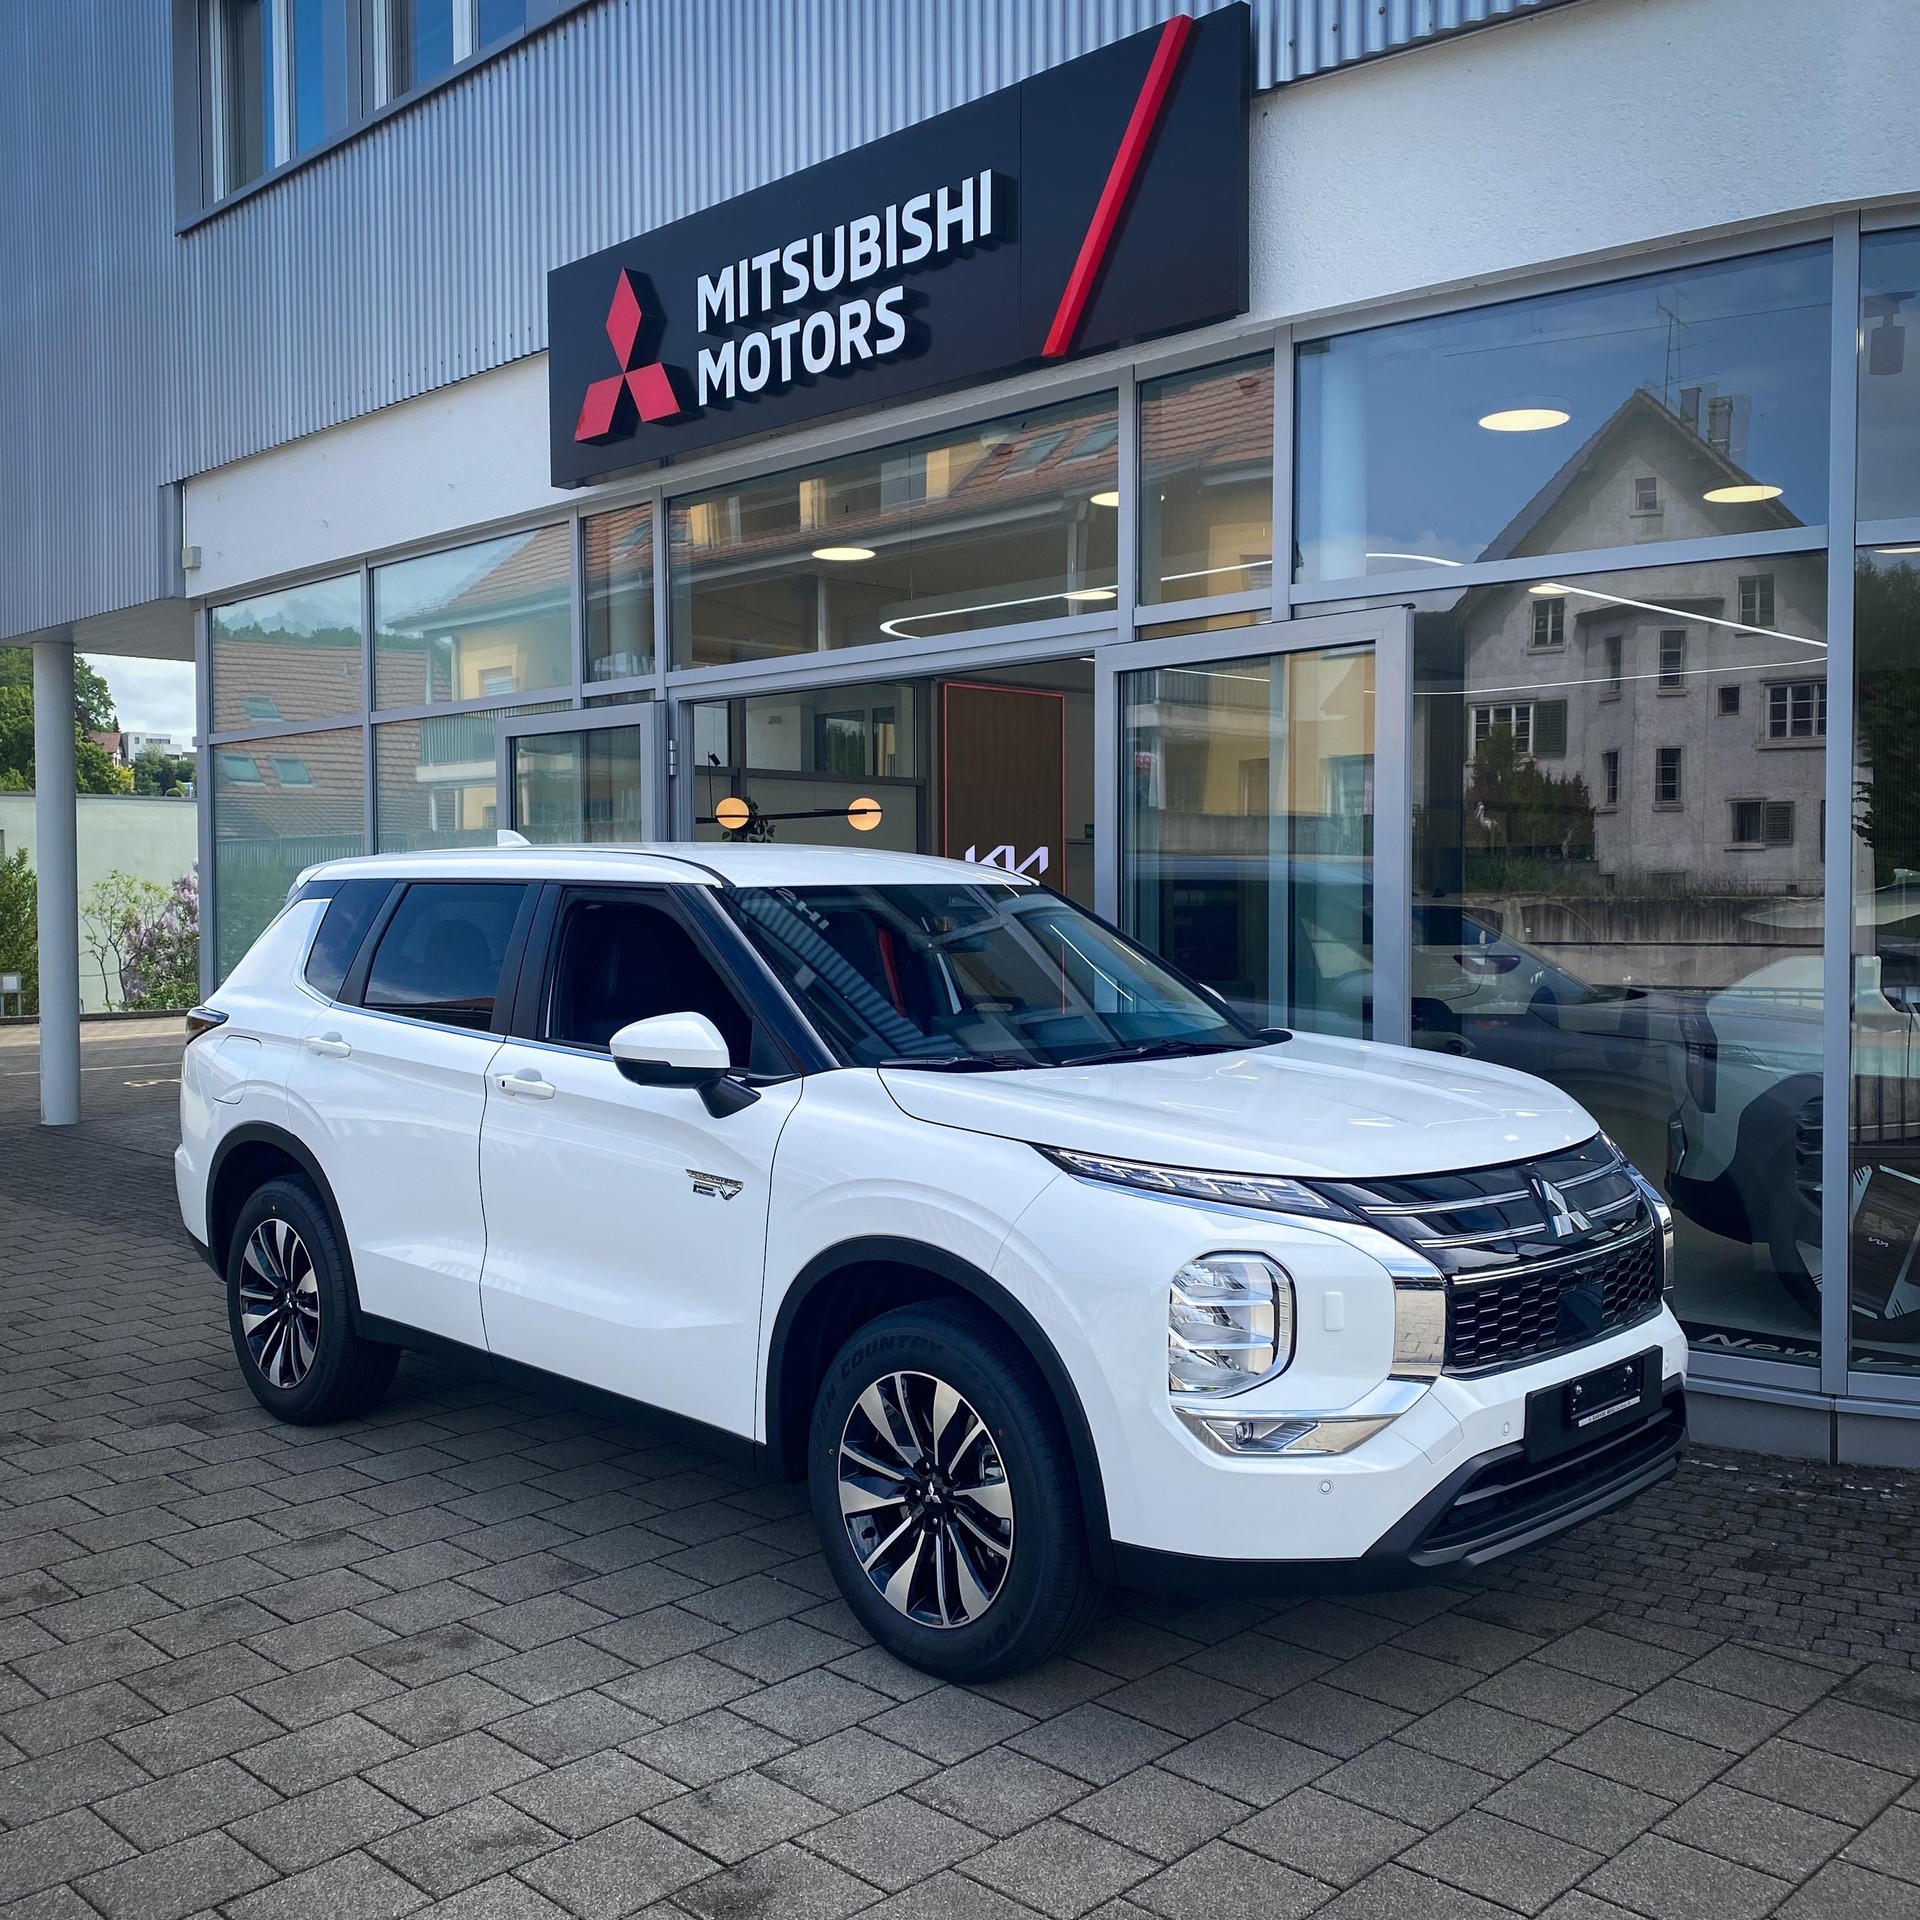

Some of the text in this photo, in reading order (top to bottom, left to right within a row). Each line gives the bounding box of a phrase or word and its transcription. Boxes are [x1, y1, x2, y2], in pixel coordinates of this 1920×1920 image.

[697, 168, 992, 333] MITSUBISHI
[697, 286, 906, 407] MOTORS
[965, 844, 1049, 875] KIA
[840, 1334, 946, 1380] COUNTRY
